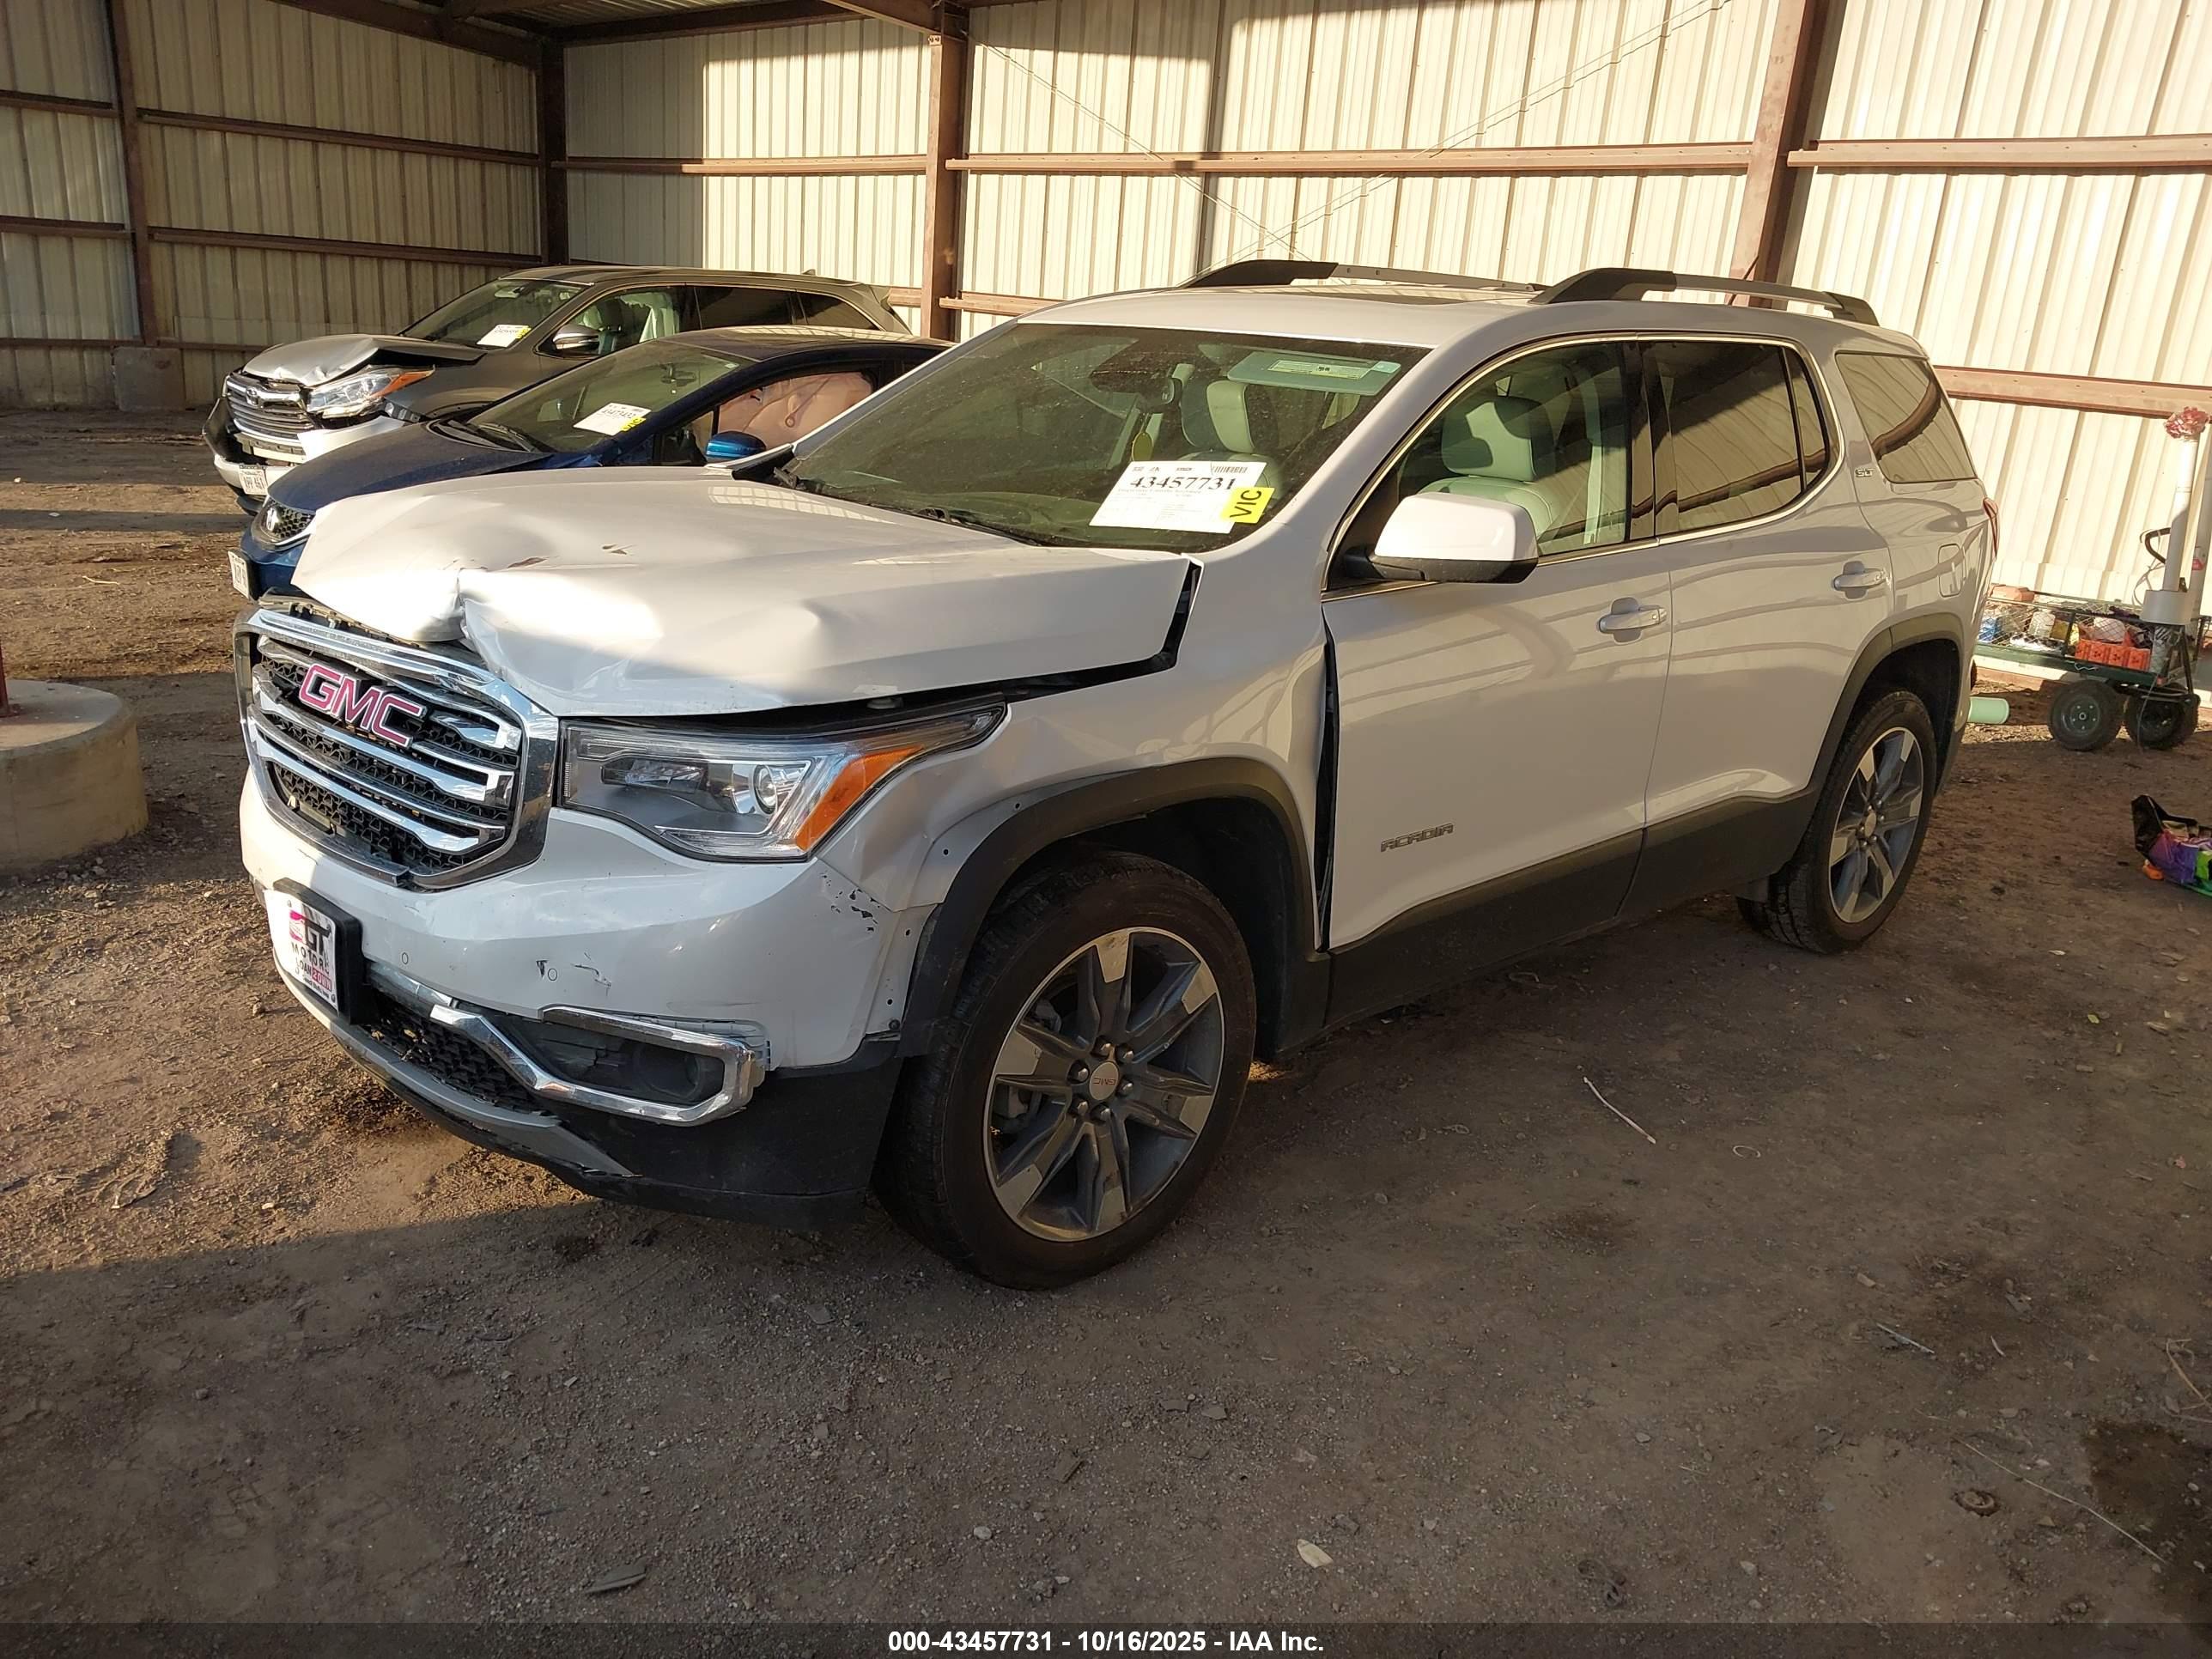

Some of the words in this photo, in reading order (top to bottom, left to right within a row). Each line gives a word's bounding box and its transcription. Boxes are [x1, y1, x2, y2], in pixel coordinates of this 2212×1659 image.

[1130, 477, 1237, 490] 43457731
[1230, 489, 1262, 518] VIC
[299, 663, 424, 749] GMC
[1381, 823, 1454, 852] ACADIA
[290, 941, 330, 975] MOTORS
